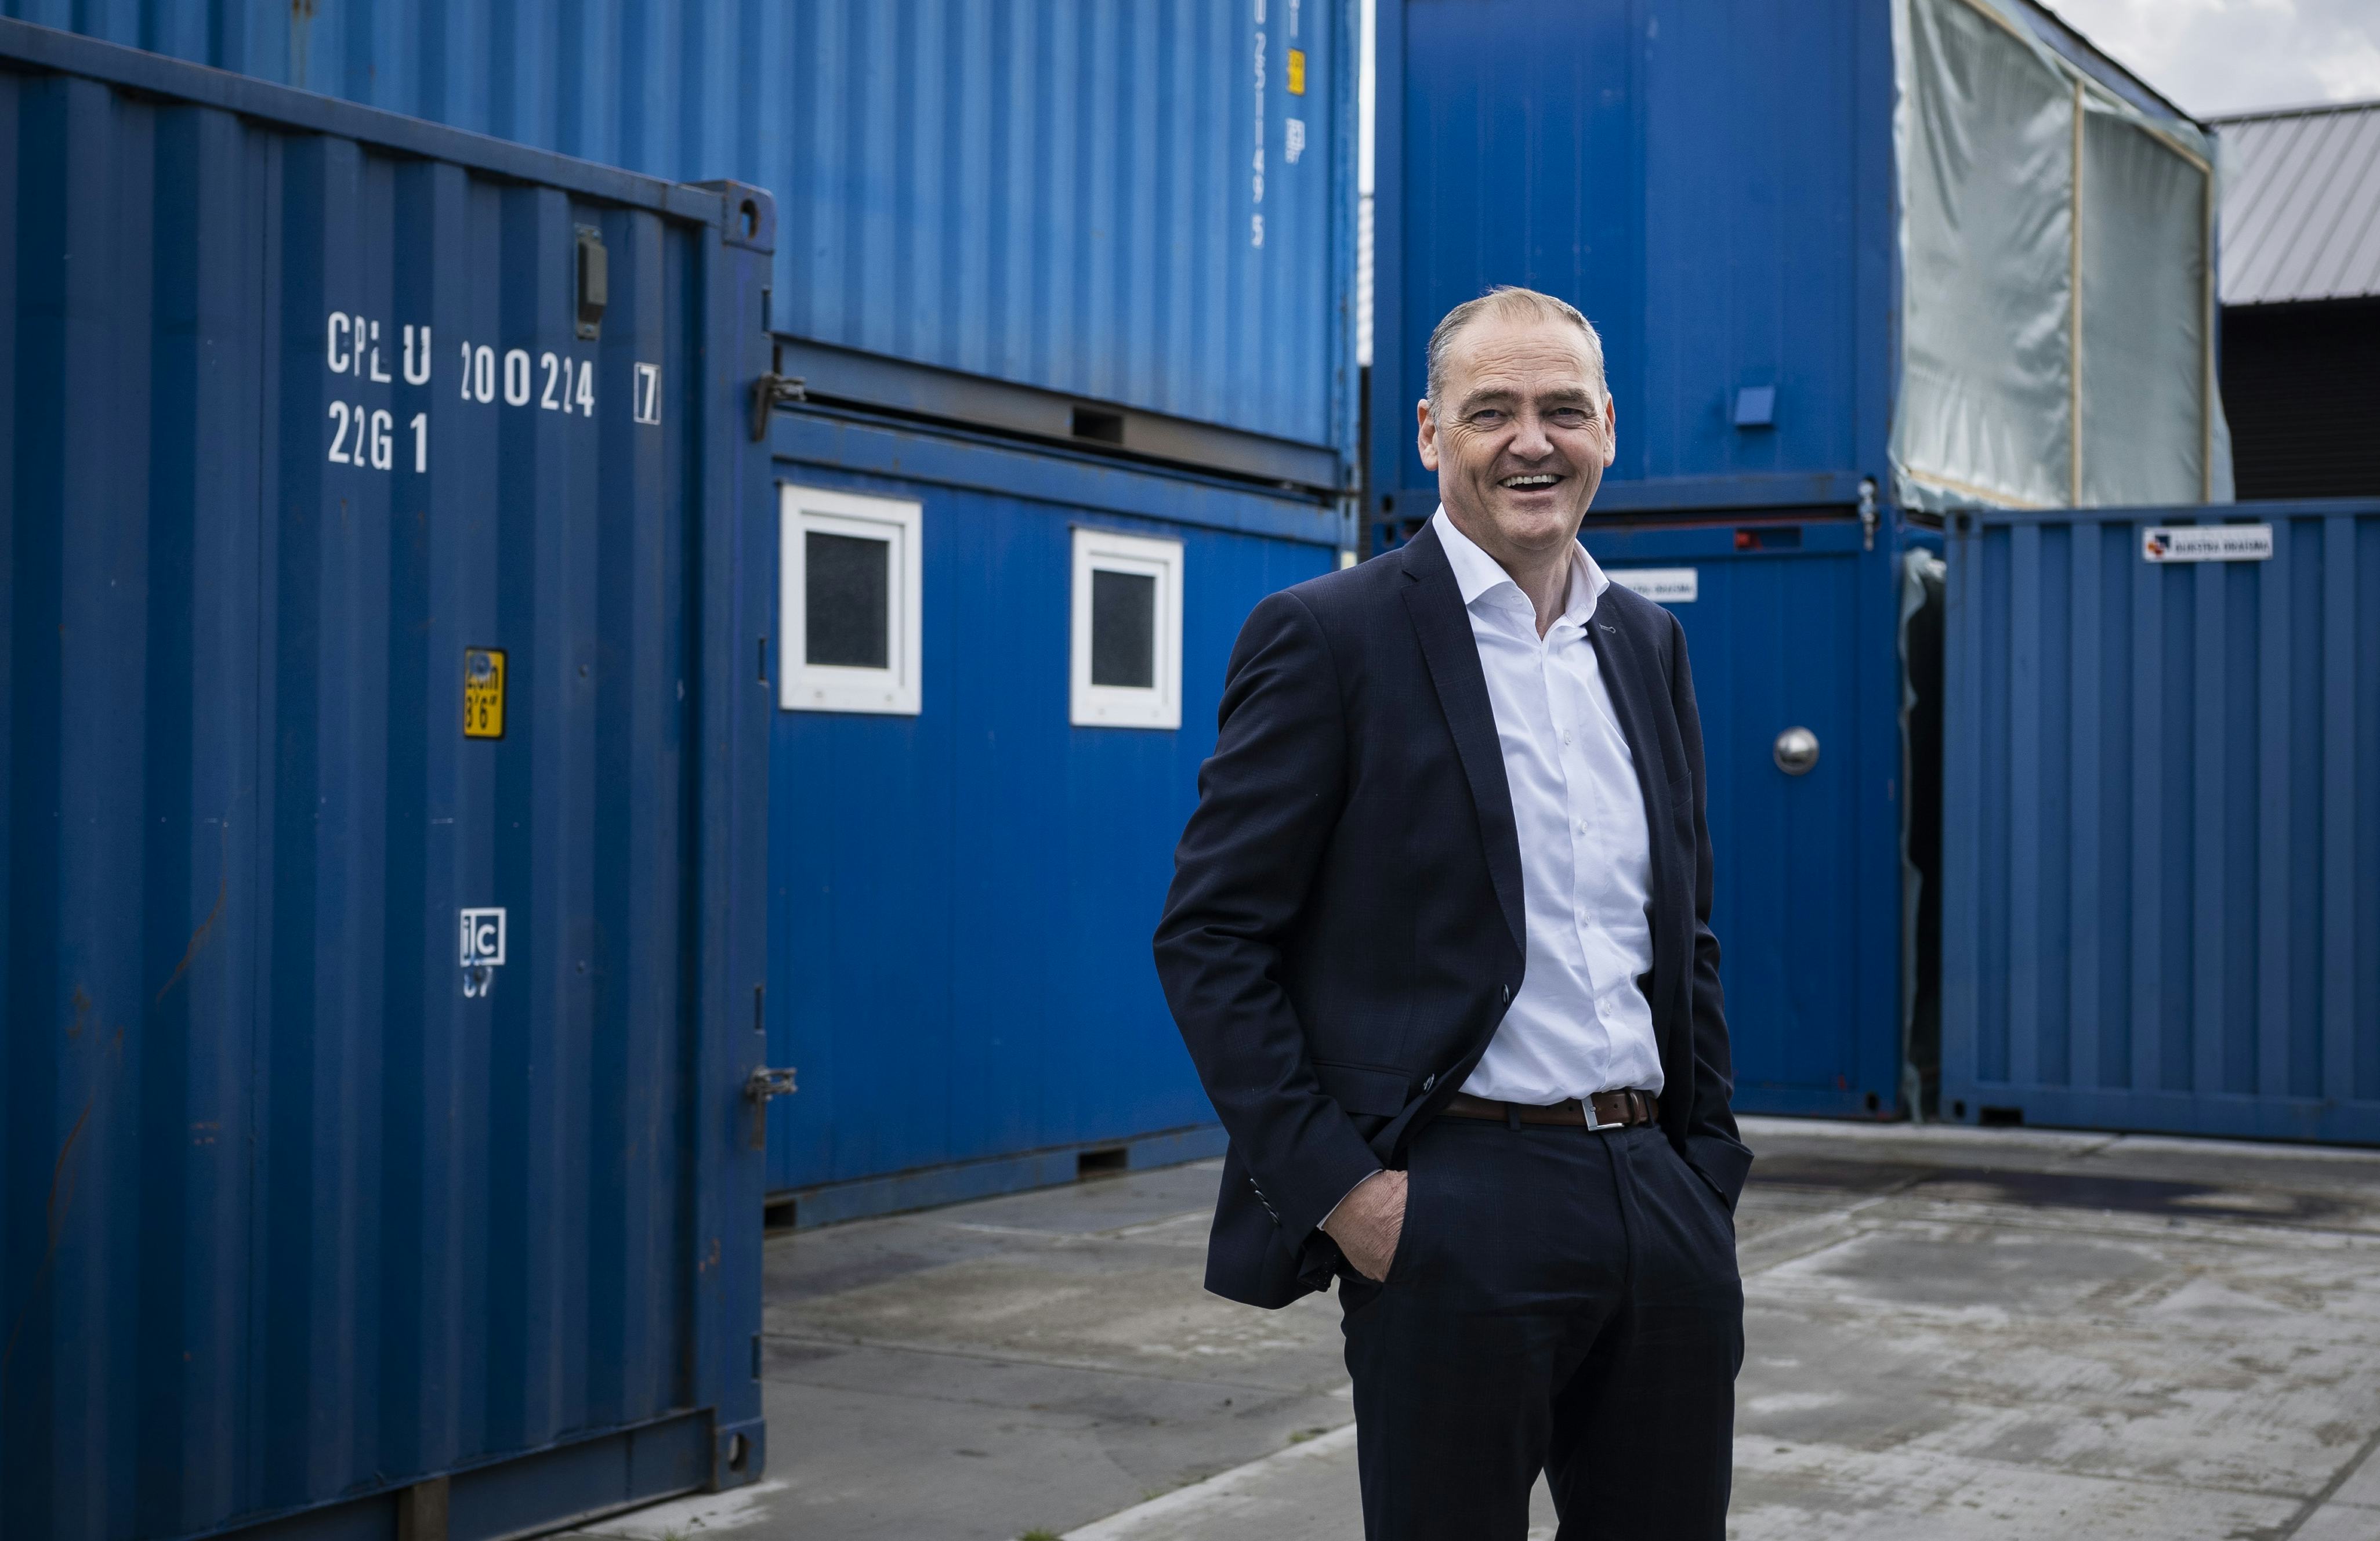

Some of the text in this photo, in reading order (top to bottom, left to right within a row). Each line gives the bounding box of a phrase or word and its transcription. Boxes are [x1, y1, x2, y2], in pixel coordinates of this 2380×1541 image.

[328, 311, 657, 422] CPLU 200224 7
